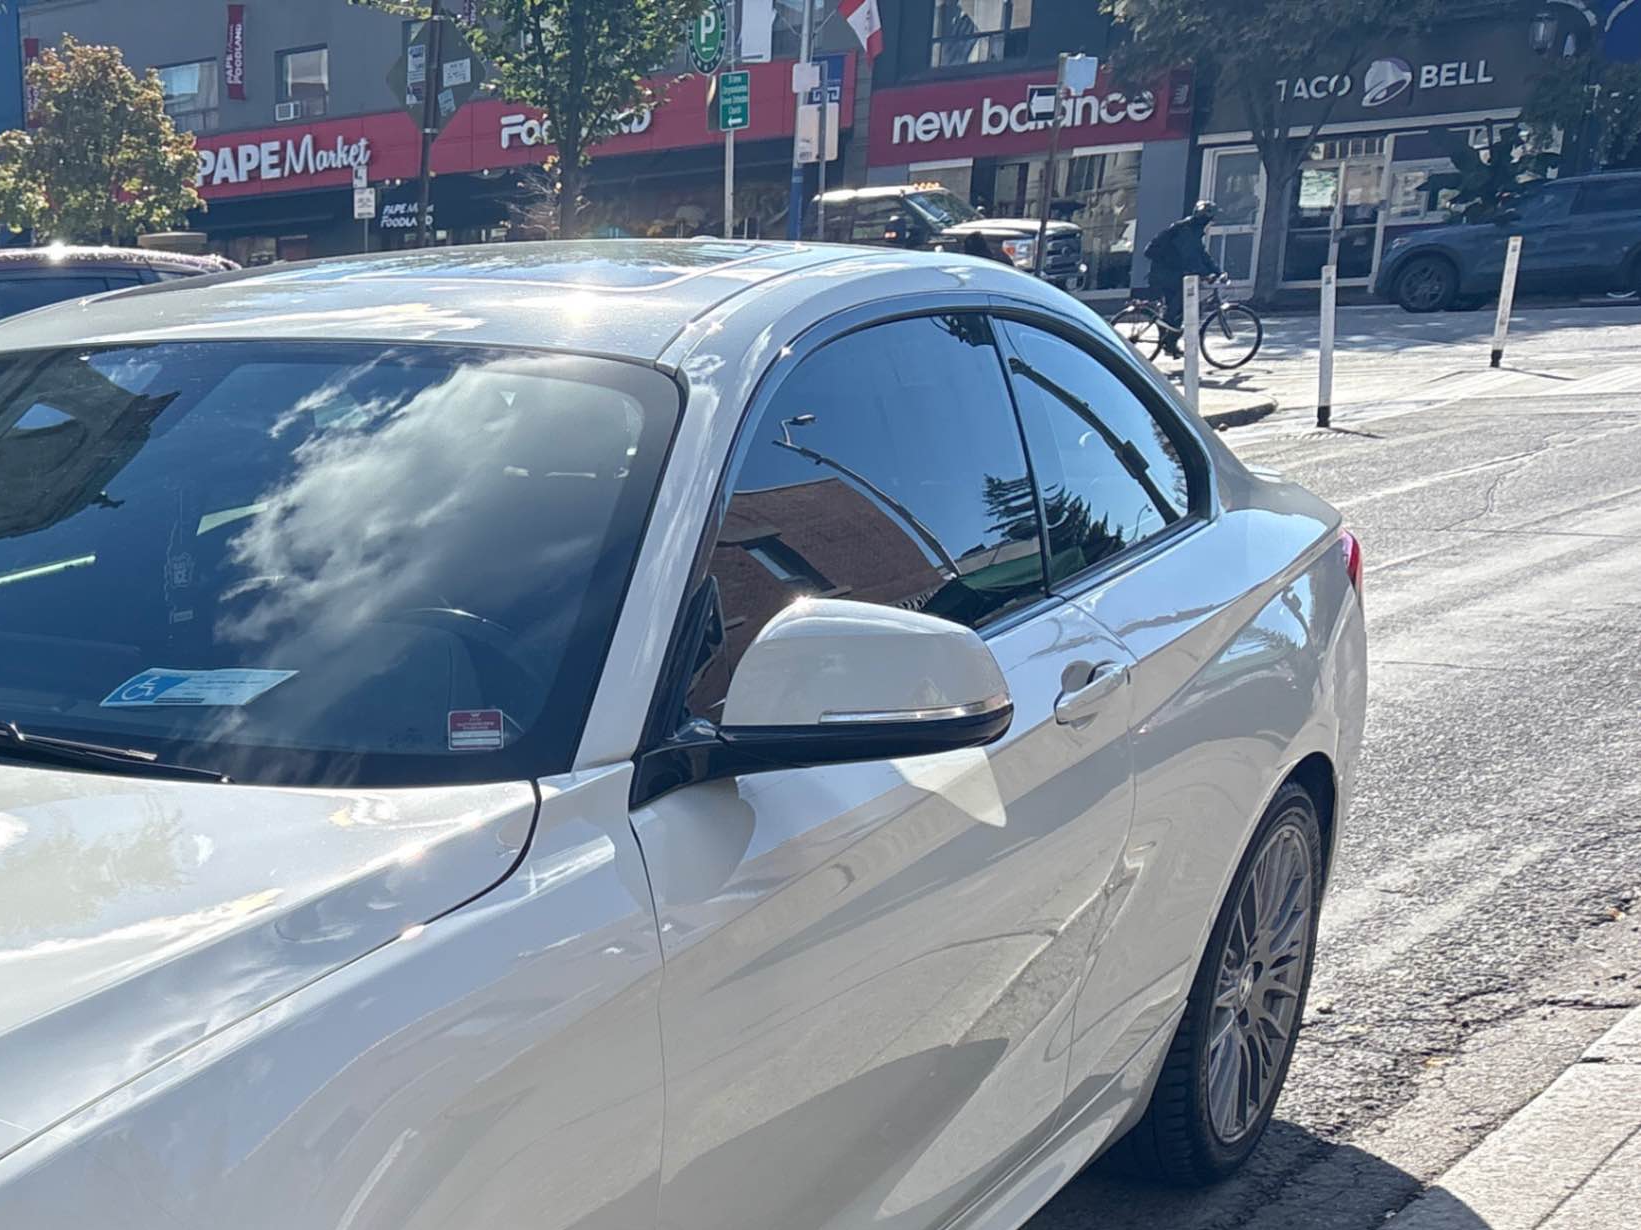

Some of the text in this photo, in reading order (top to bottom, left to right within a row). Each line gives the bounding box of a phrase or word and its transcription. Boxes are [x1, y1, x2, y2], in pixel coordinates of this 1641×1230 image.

[1275, 60, 1493, 102] TACO BELL
[892, 89, 1155, 144] new baance
[197, 134, 370, 187] PAPE Market
[380, 215, 433, 228] FOODLAD
